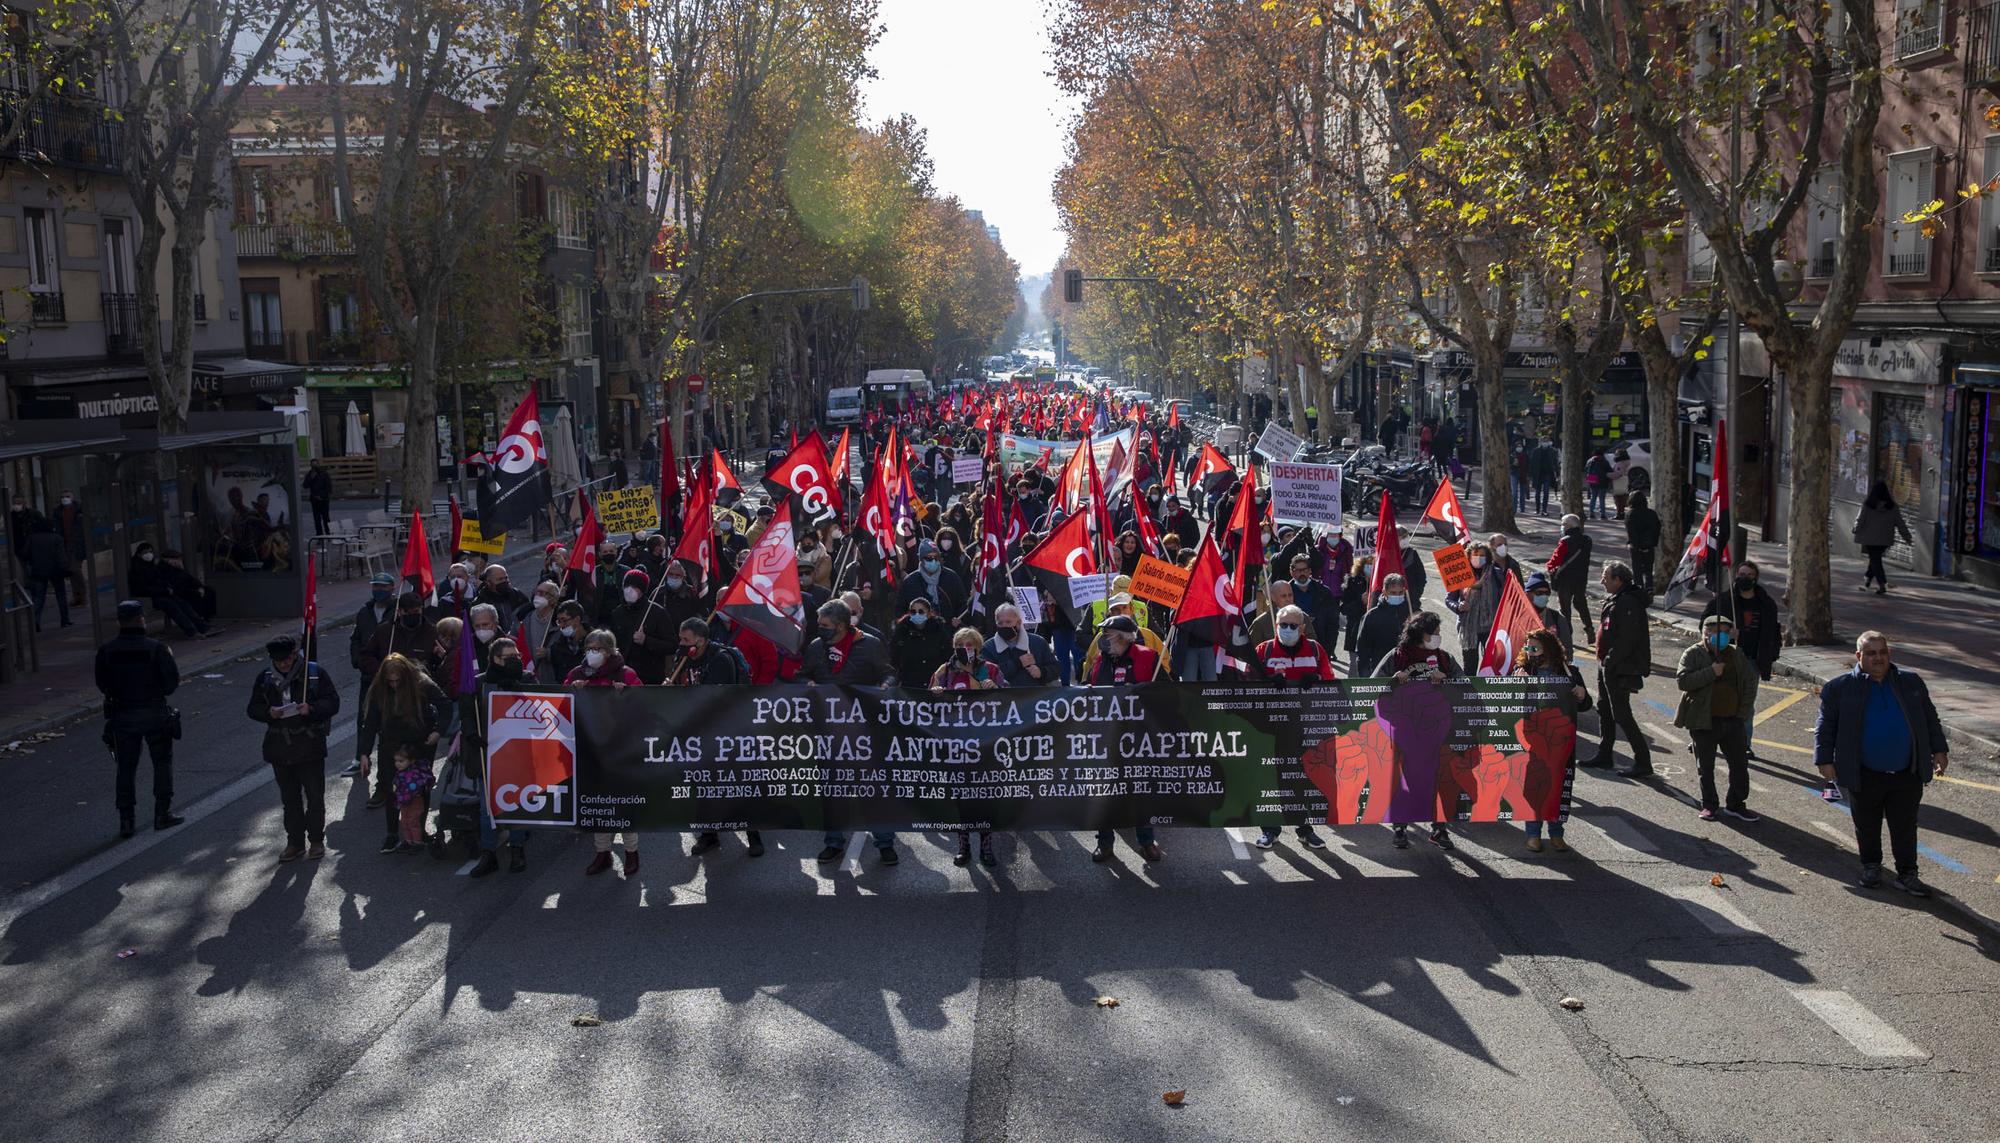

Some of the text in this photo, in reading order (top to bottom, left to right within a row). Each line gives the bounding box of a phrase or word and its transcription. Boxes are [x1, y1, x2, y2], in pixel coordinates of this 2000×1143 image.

[1271, 465, 1339, 482] ¡DESPIERTA!
[1291, 482, 1320, 491] CUANDO
[1274, 490, 1293, 498] TODO
[1295, 491, 1308, 499] SEA
[1285, 500, 1300, 508] NOS
[1278, 508, 1336, 520] PRIVADO DE TODO
[1134, 581, 1145, 592] no
[1144, 583, 1156, 596] tan
[1528, 677, 1538, 685] DE
[1201, 688, 1232, 696] AUMENTO
[1515, 692, 1525, 700] DE
[752, 695, 1145, 727] POR LA JUSTÍCIA SOCIAL
[1255, 702, 1265, 710] DE
[1340, 713, 1350, 721] LA
[643, 730, 1248, 768] LAS PERSONAS ANTES QUE EL CAPITAL
[1261, 757, 1284, 765] PACTO
[683, 764, 1212, 784] POR LA DEROGACIÓN DE LAS REFORMAS LABORALES Y LEYES REPRESIVAS
[671, 779, 1224, 801] EN DEFENSA DE LO PÚBLICO Y DE LAS PENSIONES, GARANTIZAR EL IPC REAL
[495, 783, 569, 814] CGT
[580, 794, 646, 806] Confederación
[580, 806, 616, 817] General
[580, 818, 631, 830] del Trabajo
[1150, 815, 1174, 825] @CGT
[690, 821, 749, 831] www.cgt.org.es
[912, 820, 992, 832] www.rojoynegro.info
